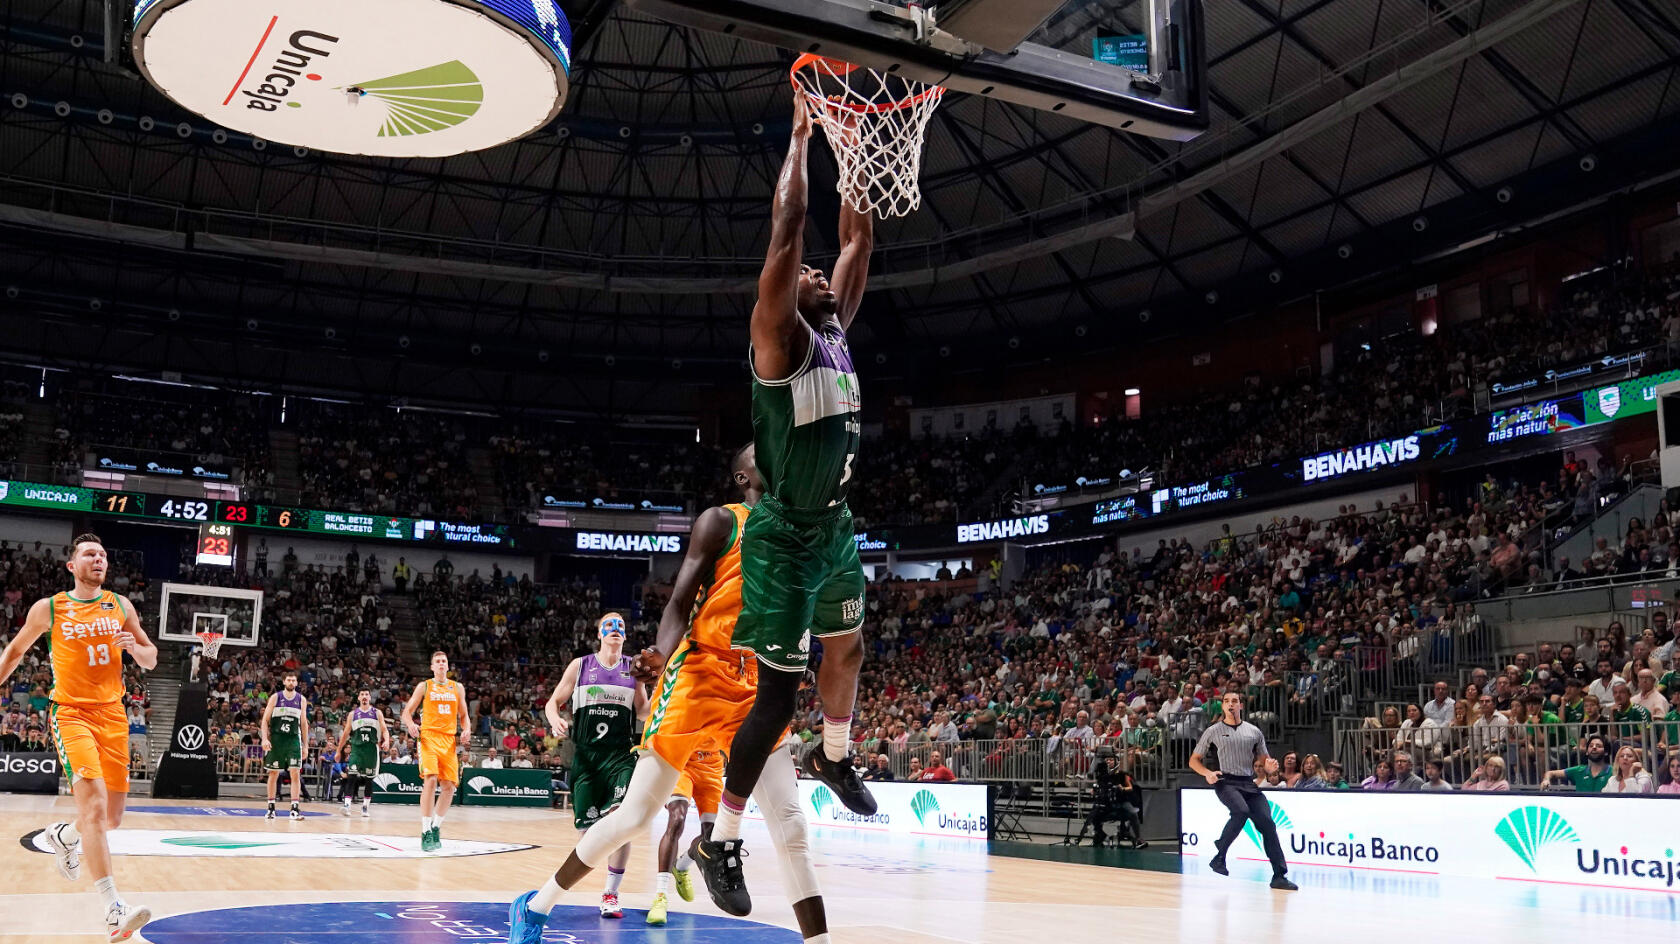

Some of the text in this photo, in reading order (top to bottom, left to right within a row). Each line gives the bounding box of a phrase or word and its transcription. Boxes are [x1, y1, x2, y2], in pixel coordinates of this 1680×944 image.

[242, 30, 339, 112] Unicaja
[1303, 435, 1420, 481] BENAHAVIS
[25, 489, 78, 503] UNICAJA
[1172, 481, 1209, 497] The most
[1203, 489, 1229, 502] choice
[107, 495, 128, 512] 11
[160, 500, 208, 520] 4:52
[226, 506, 247, 521] 23
[279, 511, 291, 527] 6
[325, 514, 373, 525] REAL BETIS
[440, 522, 480, 533] The most
[958, 515, 1049, 543] BENAHAVIS
[203, 537, 229, 555] 23
[472, 533, 501, 544] choice
[576, 532, 681, 553] BENAHAVIS
[860, 540, 887, 550] choice
[61, 617, 121, 637] Sevilla
[88, 644, 110, 666] 13
[603, 693, 625, 702] Unicaja
[588, 707, 618, 718] málaga
[280, 724, 290, 733] 45
[592, 723, 609, 742] 9
[398, 783, 425, 792] Unica
[492, 785, 549, 796] Unicaja Banco
[832, 805, 862, 825] Unicaja
[939, 812, 977, 834] Unicaja
[1290, 831, 1439, 863] Unicaja Banco
[1577, 846, 1680, 887] Unicaj
